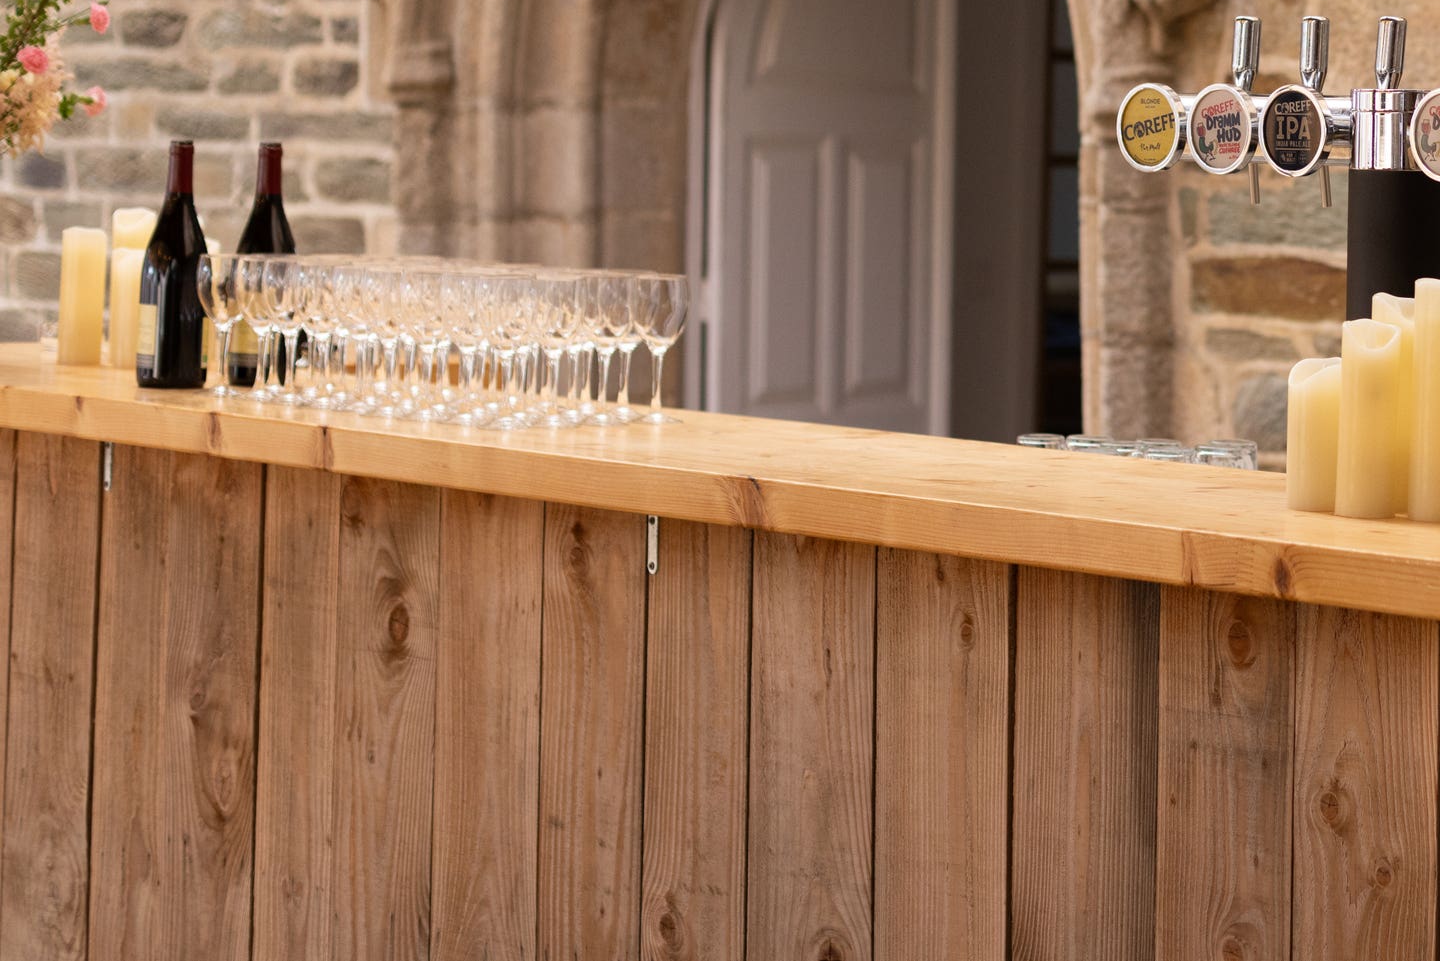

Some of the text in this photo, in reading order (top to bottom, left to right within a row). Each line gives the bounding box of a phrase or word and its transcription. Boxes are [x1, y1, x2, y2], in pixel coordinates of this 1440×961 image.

[1201, 99, 1234, 119] COREFF
[1274, 99, 1311, 114] COREFF
[1124, 112, 1176, 141] COREFF
[1216, 127, 1241, 143] HUD
[1276, 116, 1311, 140] IPA
